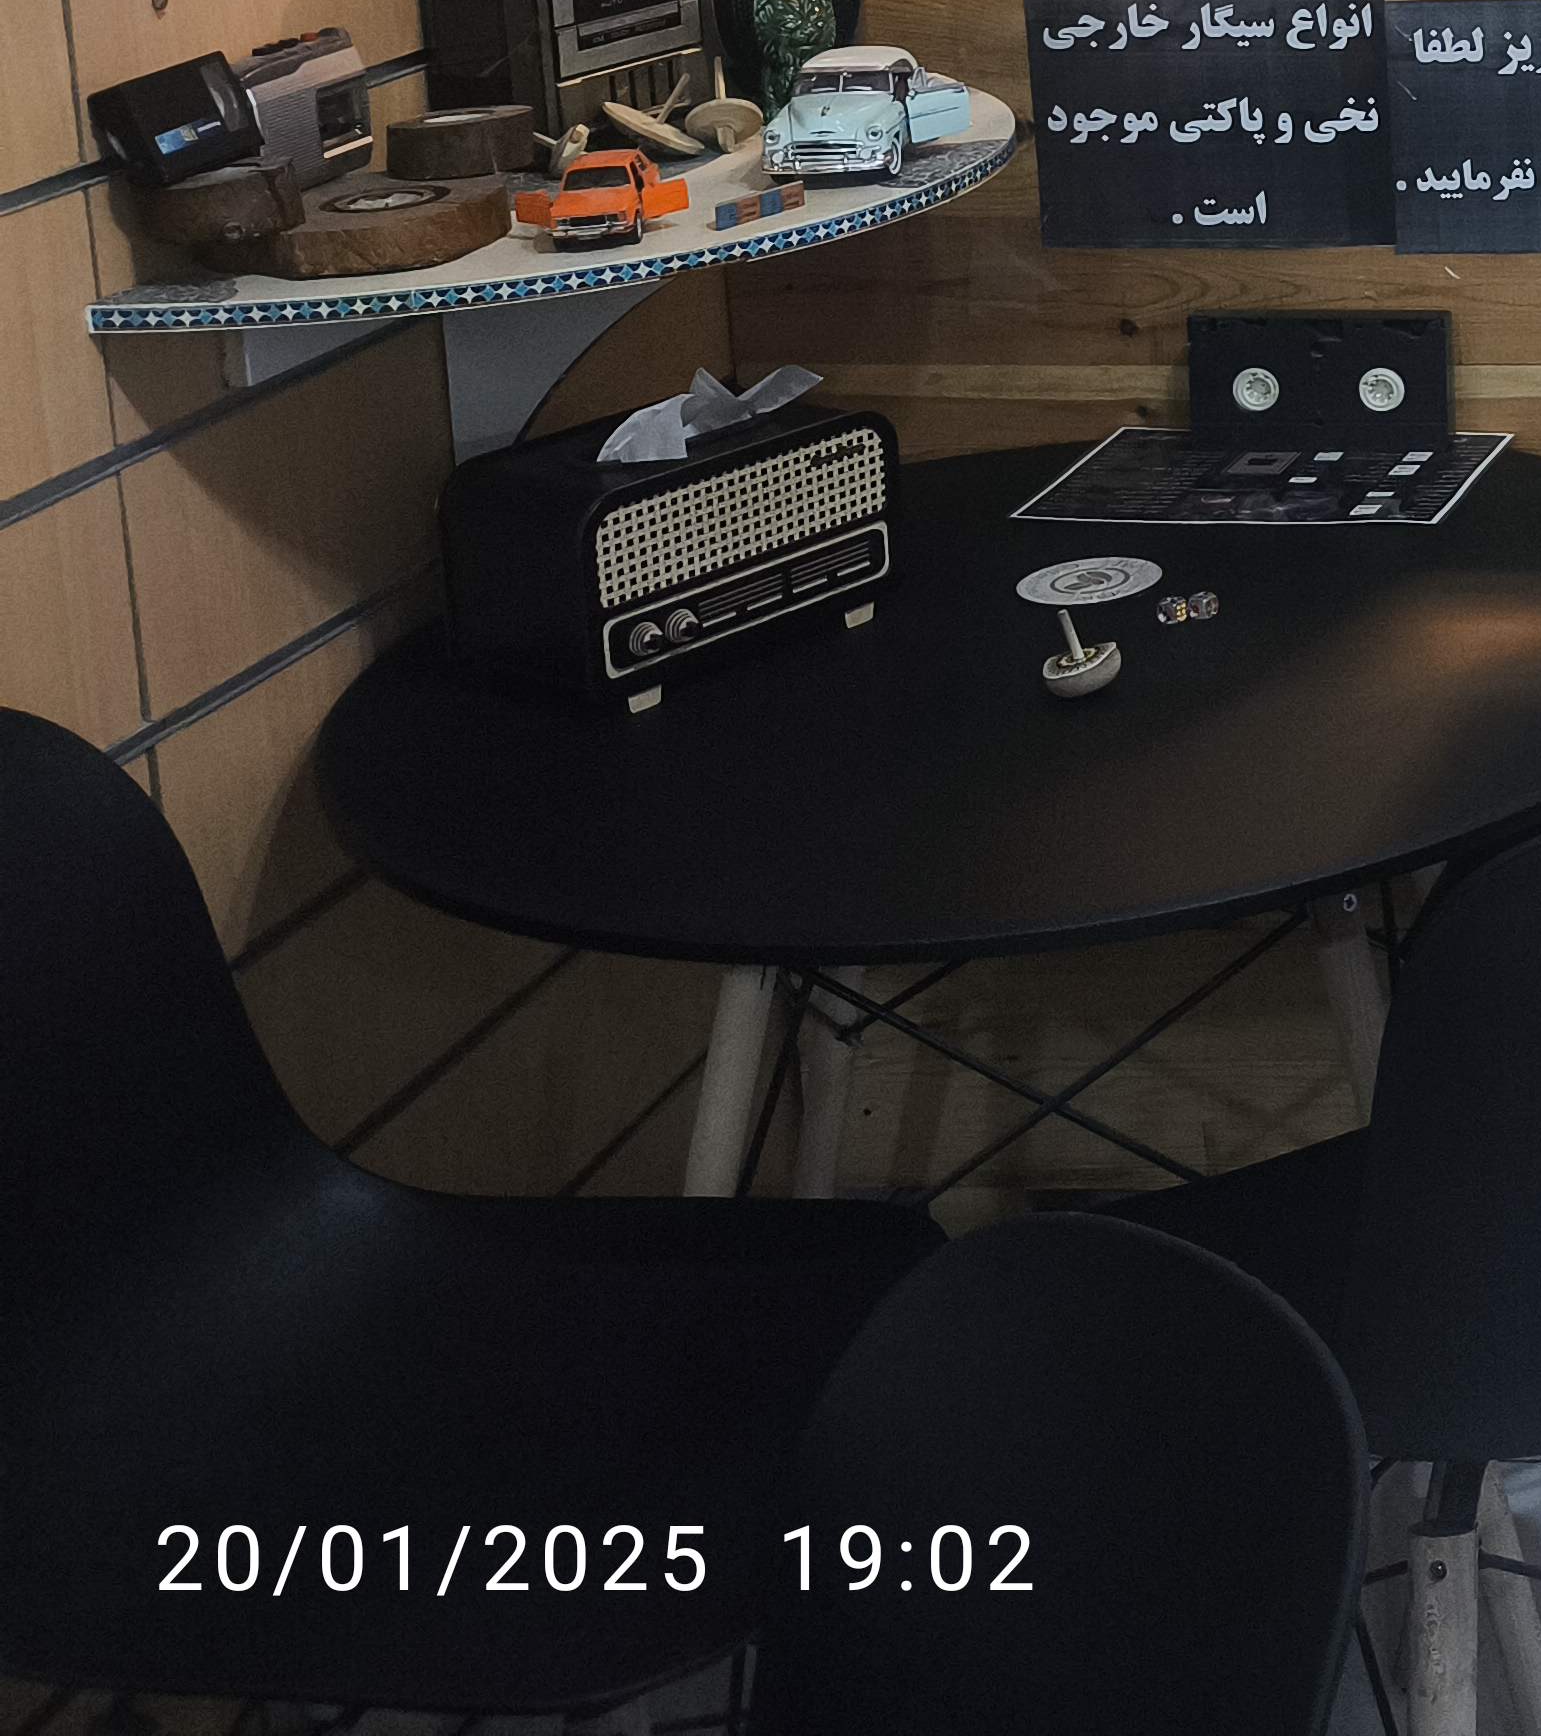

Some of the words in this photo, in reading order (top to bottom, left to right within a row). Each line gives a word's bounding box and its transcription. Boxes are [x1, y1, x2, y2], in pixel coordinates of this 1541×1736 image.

[1042, 4, 1170, 50] خارجی
[1182, 3, 1275, 50] سیگار
[1286, 2, 1373, 50] انواع
[1414, 26, 1485, 63] لطفا
[1047, 106, 1159, 144] موجود
[1168, 98, 1267, 144] پاکتی
[1275, 112, 1293, 143] و
[1304, 99, 1380, 142] نخی
[1418, 156, 1534, 201] نفرمایید
[1194, 191, 1268, 225] است
